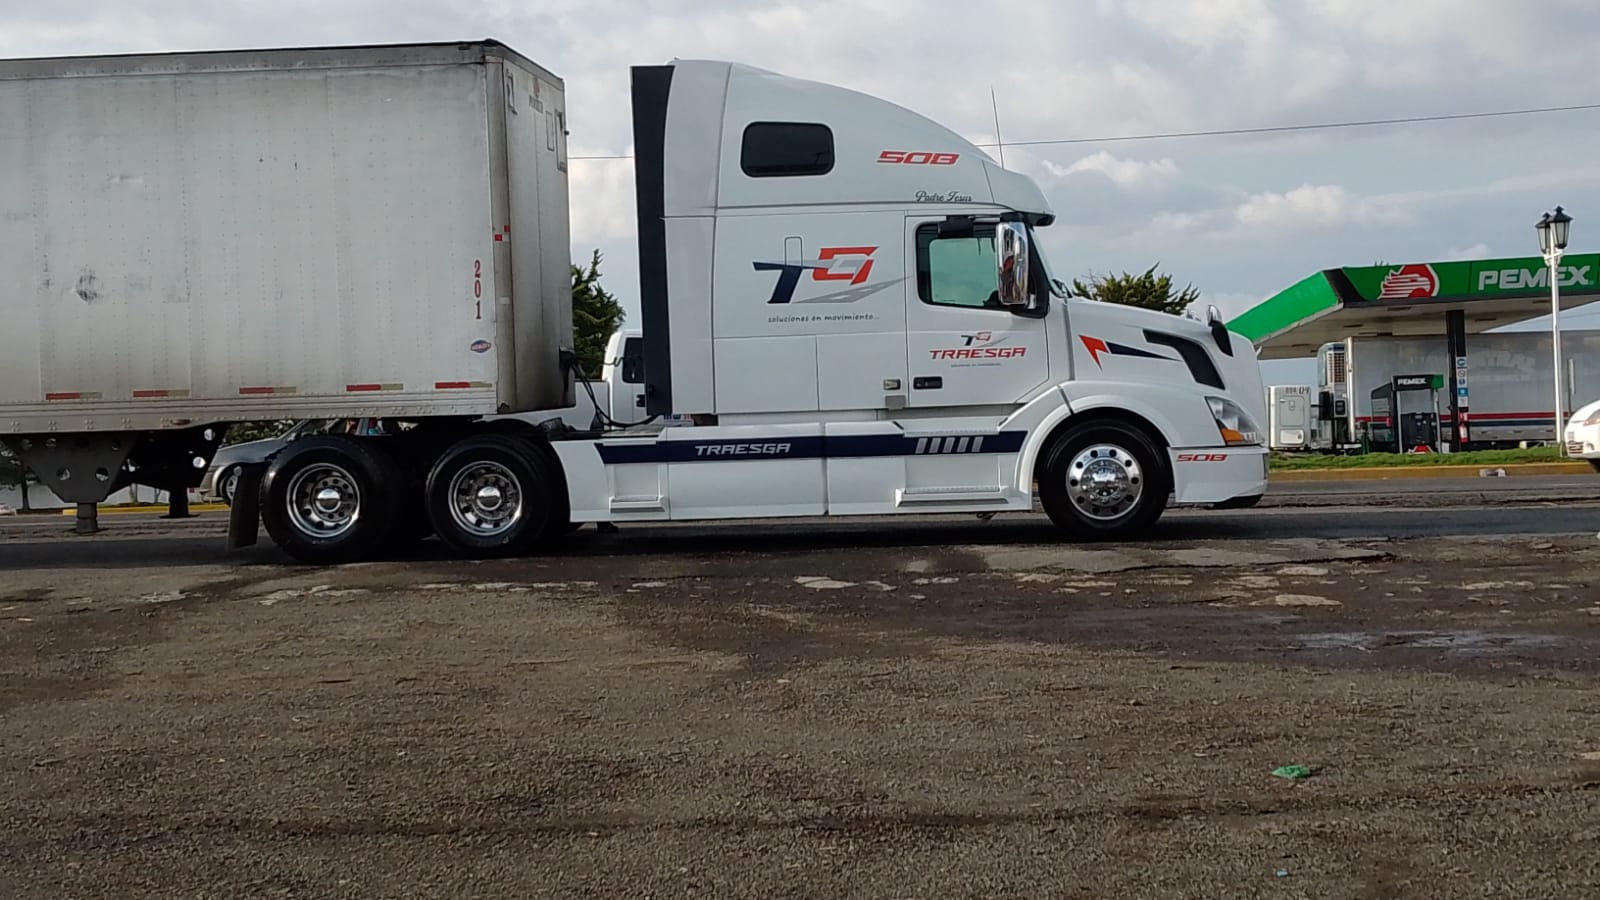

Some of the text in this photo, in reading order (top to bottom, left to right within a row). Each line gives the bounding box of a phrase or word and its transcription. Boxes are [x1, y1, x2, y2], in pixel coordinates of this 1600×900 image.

[915, 191, 945, 202] Padre
[1478, 265, 1591, 291] PEMEX
[768, 315, 809, 323] soluciones
[929, 347, 1027, 360] TRAESGA
[694, 443, 791, 456] TRAESGA
